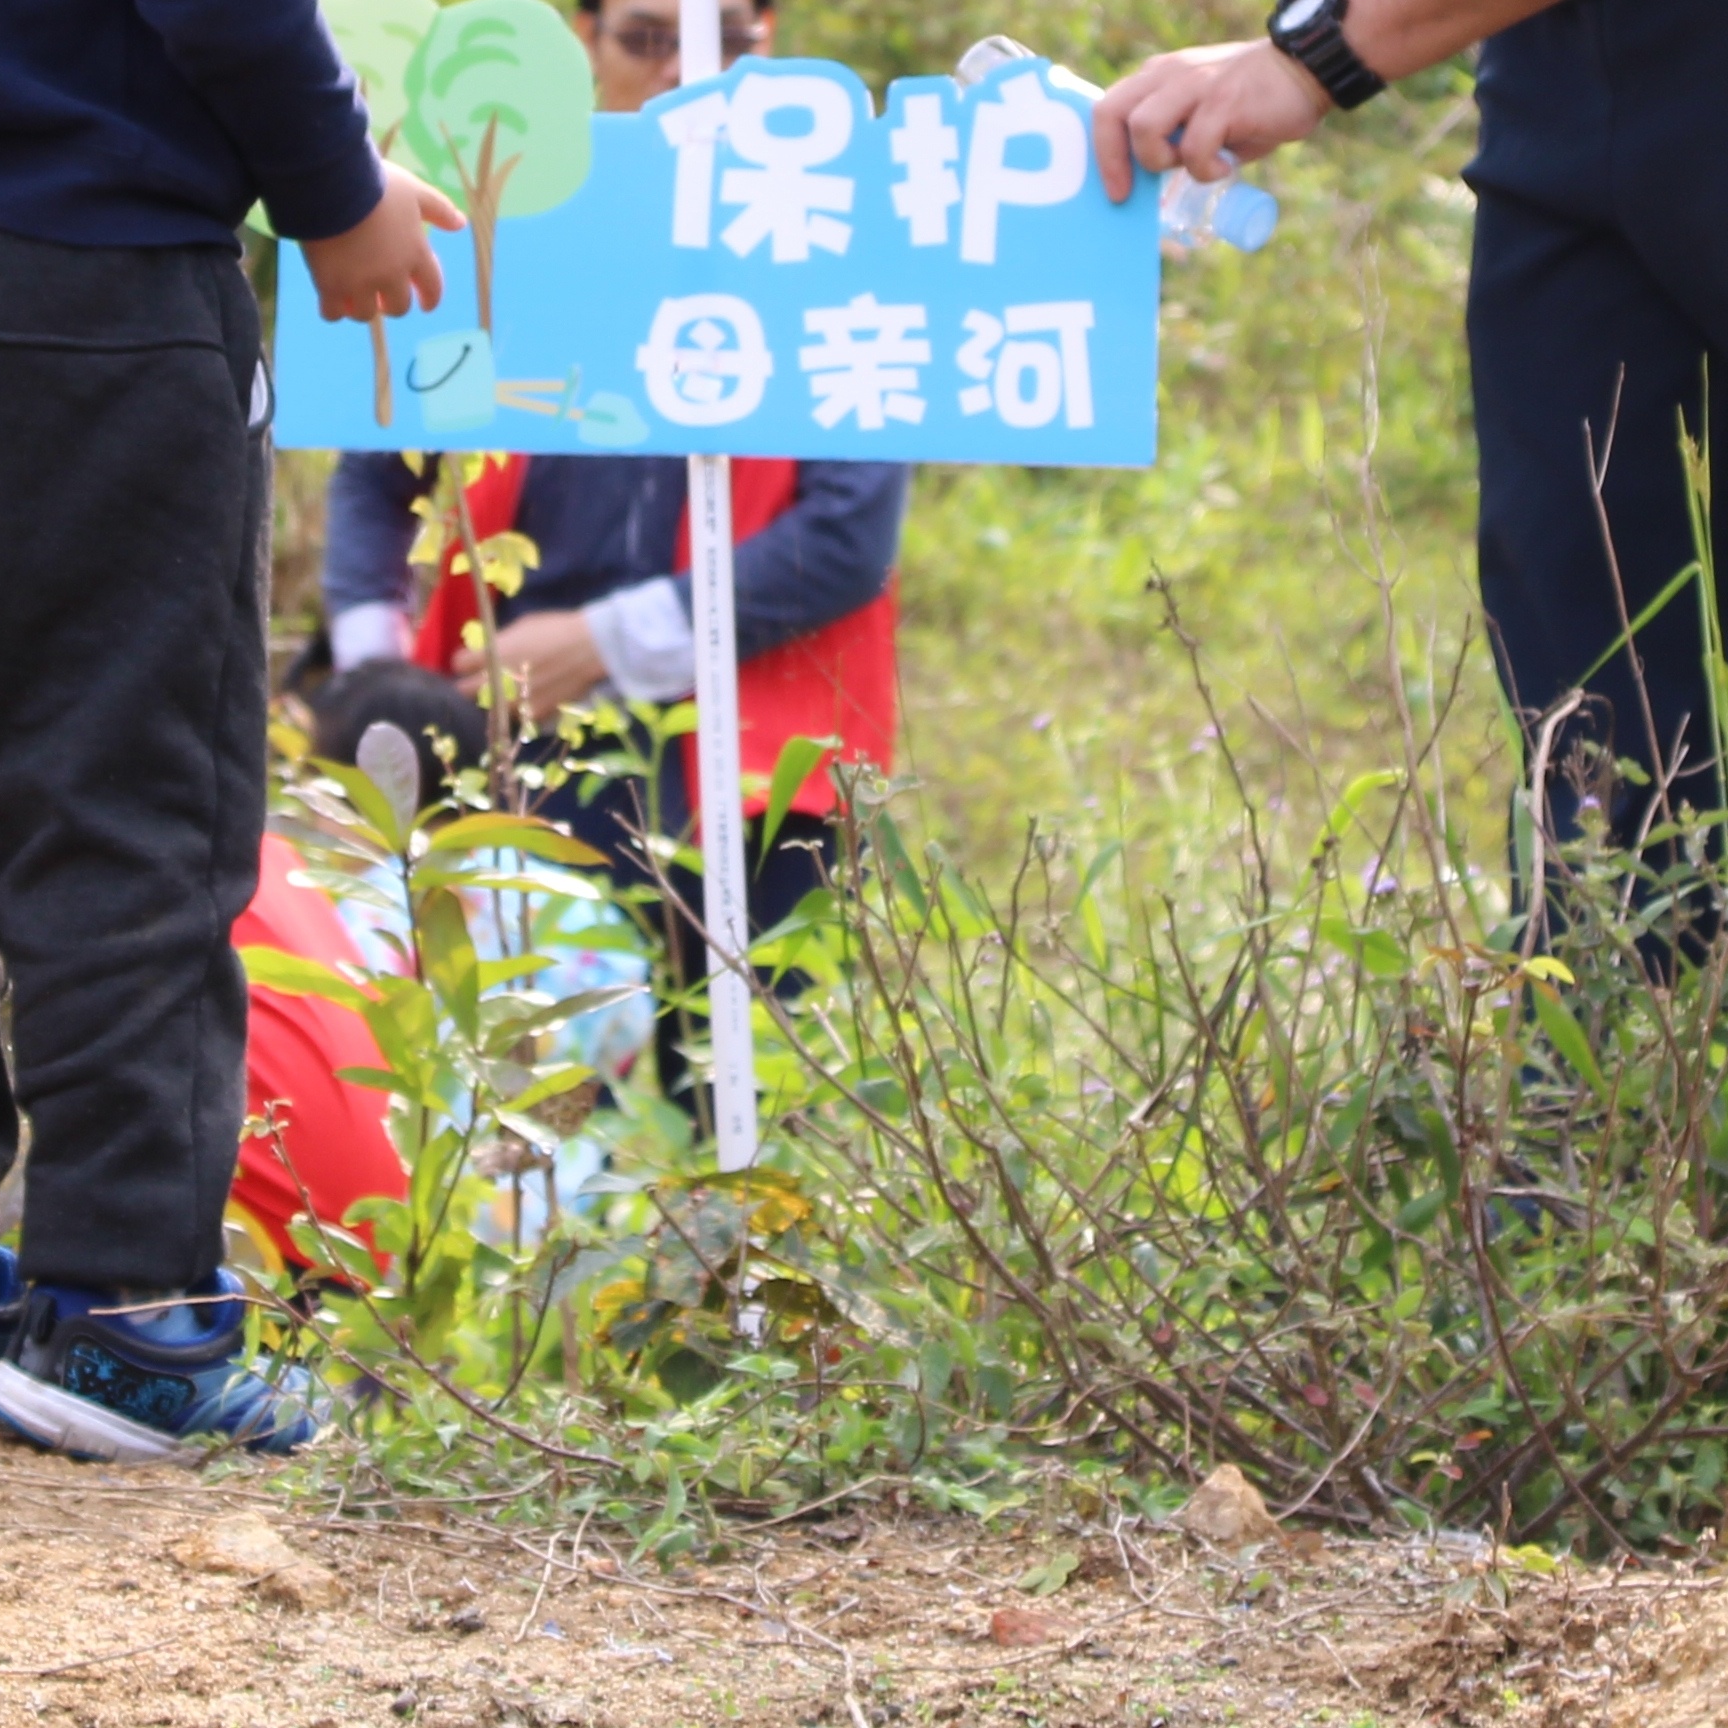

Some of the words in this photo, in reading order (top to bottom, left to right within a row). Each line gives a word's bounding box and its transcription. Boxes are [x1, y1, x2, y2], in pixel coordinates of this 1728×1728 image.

[660, 73, 1086, 264] 保护
[636, 293, 1094, 430] 母亲河
